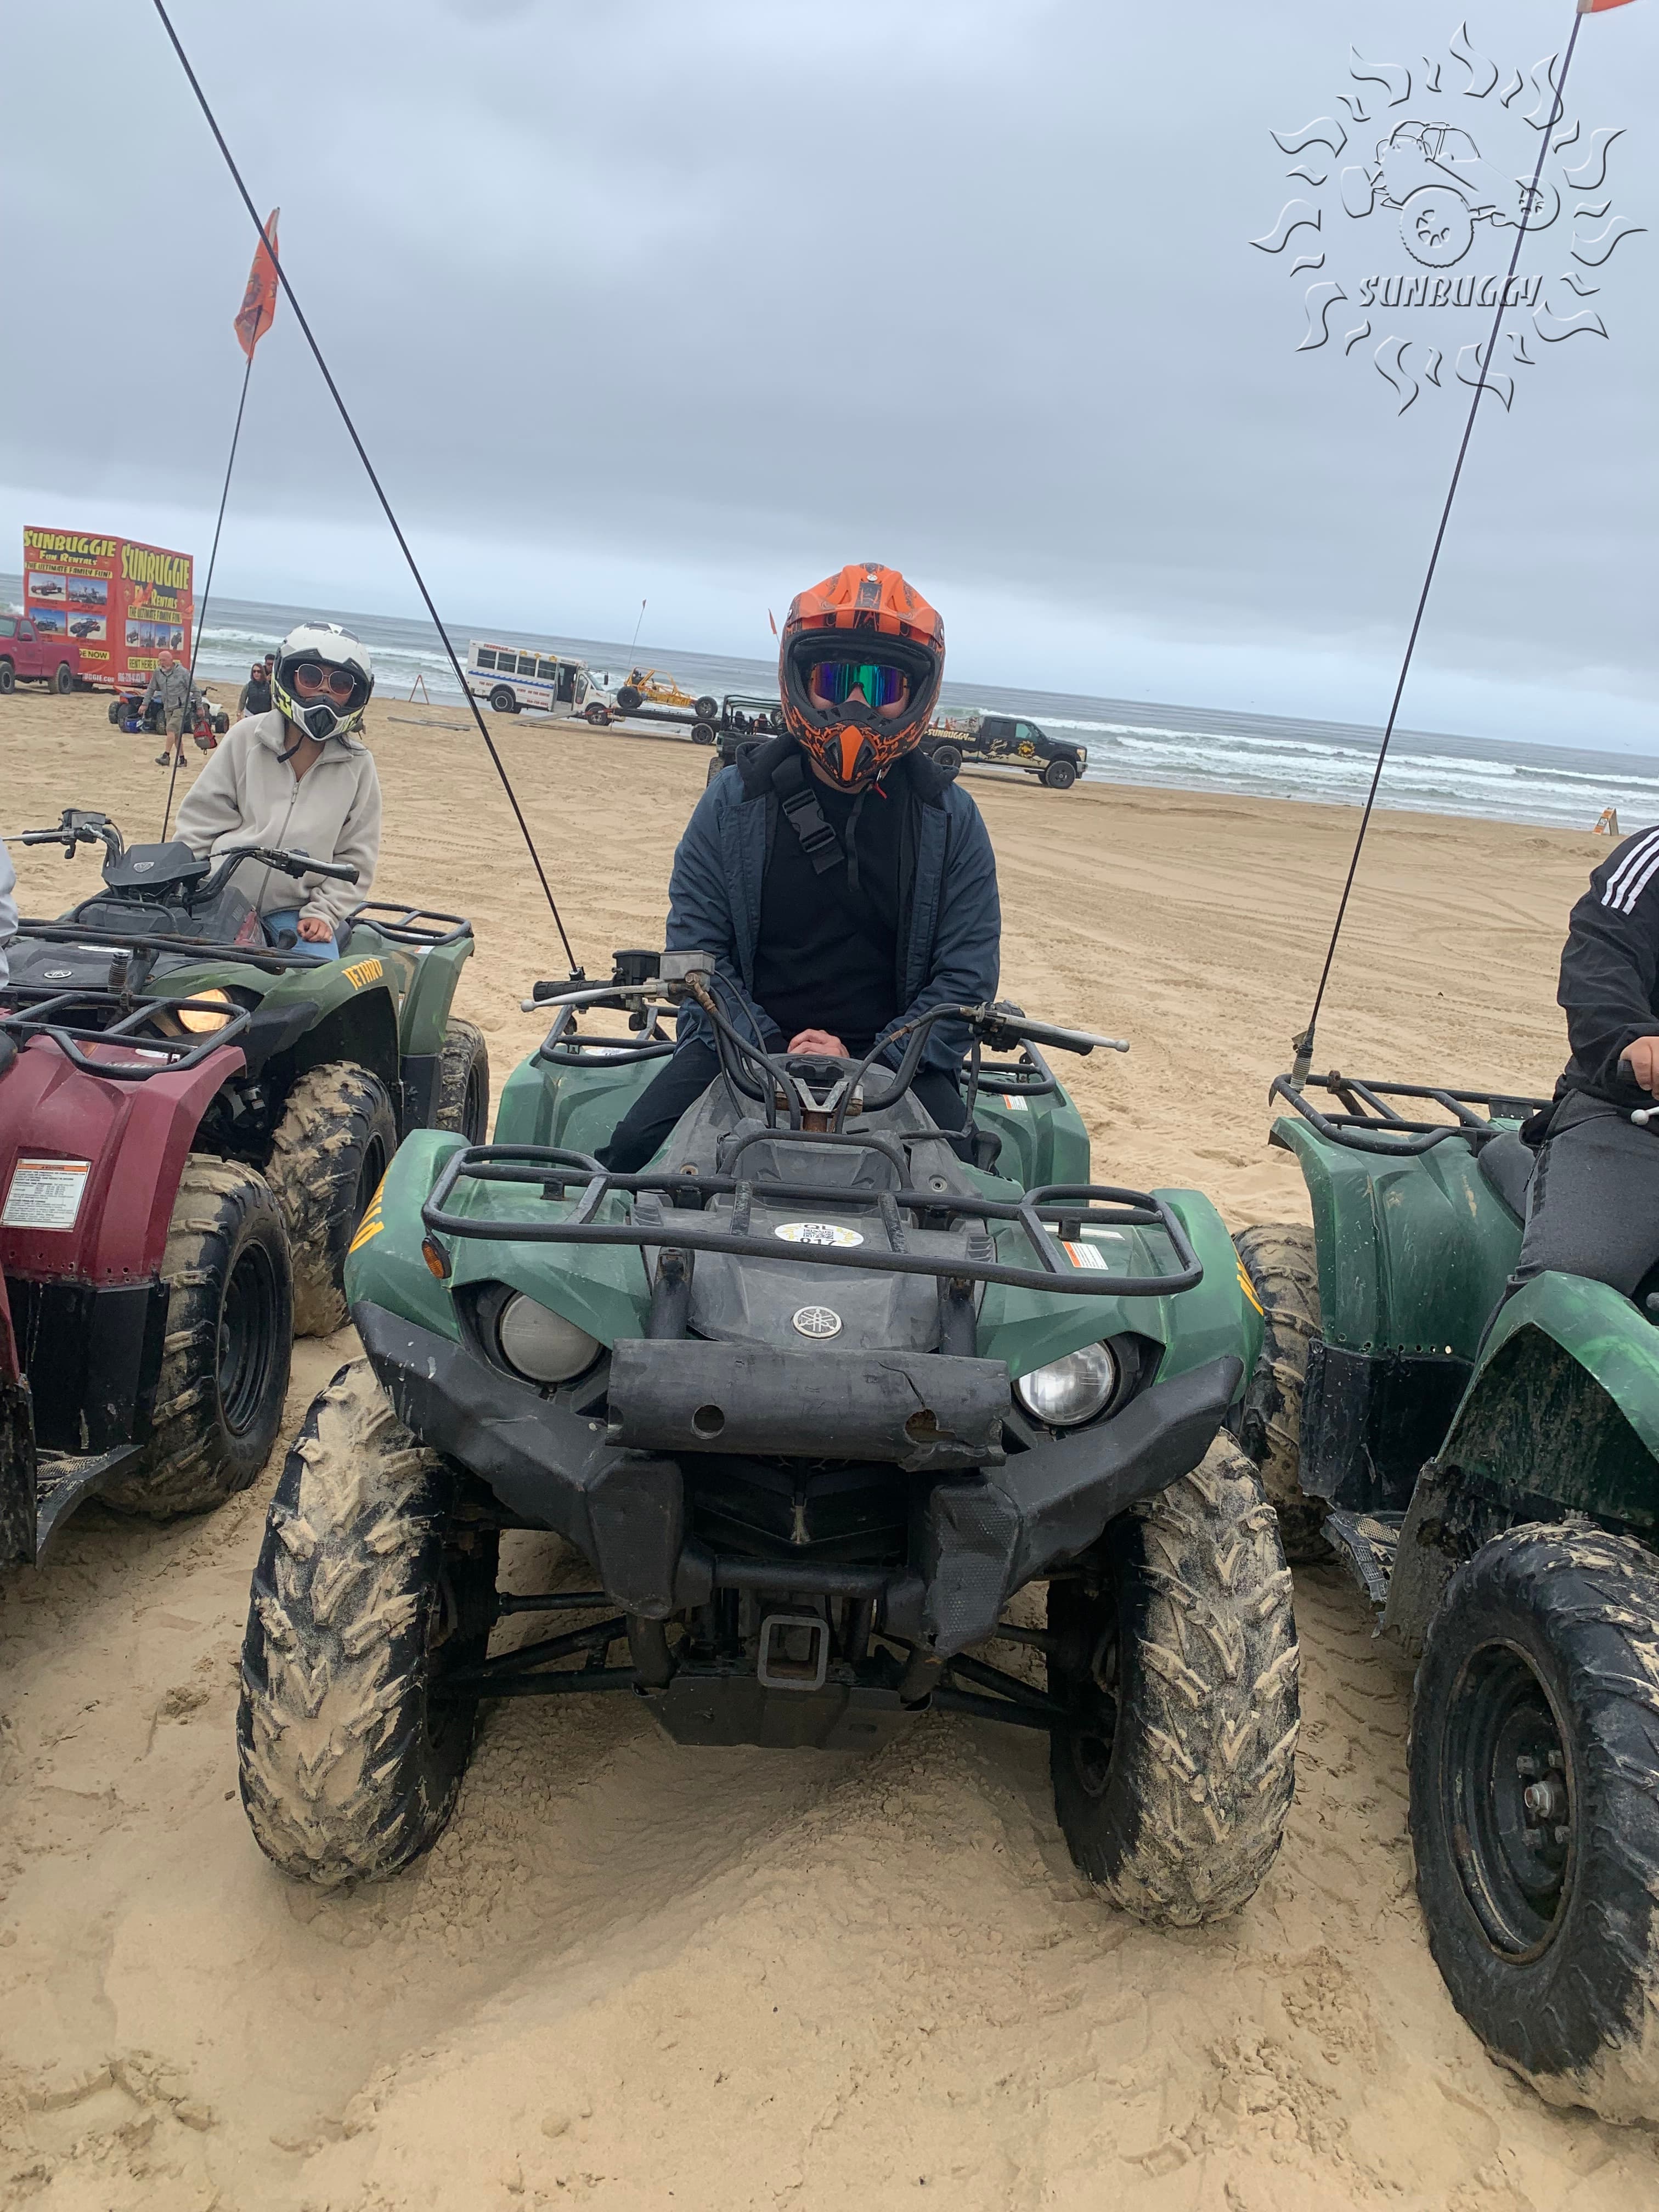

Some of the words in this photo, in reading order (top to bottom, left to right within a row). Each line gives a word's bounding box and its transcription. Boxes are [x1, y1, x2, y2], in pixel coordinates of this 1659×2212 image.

[24, 529, 117, 557] SUNBUGGIE
[121, 543, 190, 590] SUNBUGGIE
[129, 658, 140, 669] RENT
[142, 659, 153, 669] HERE
